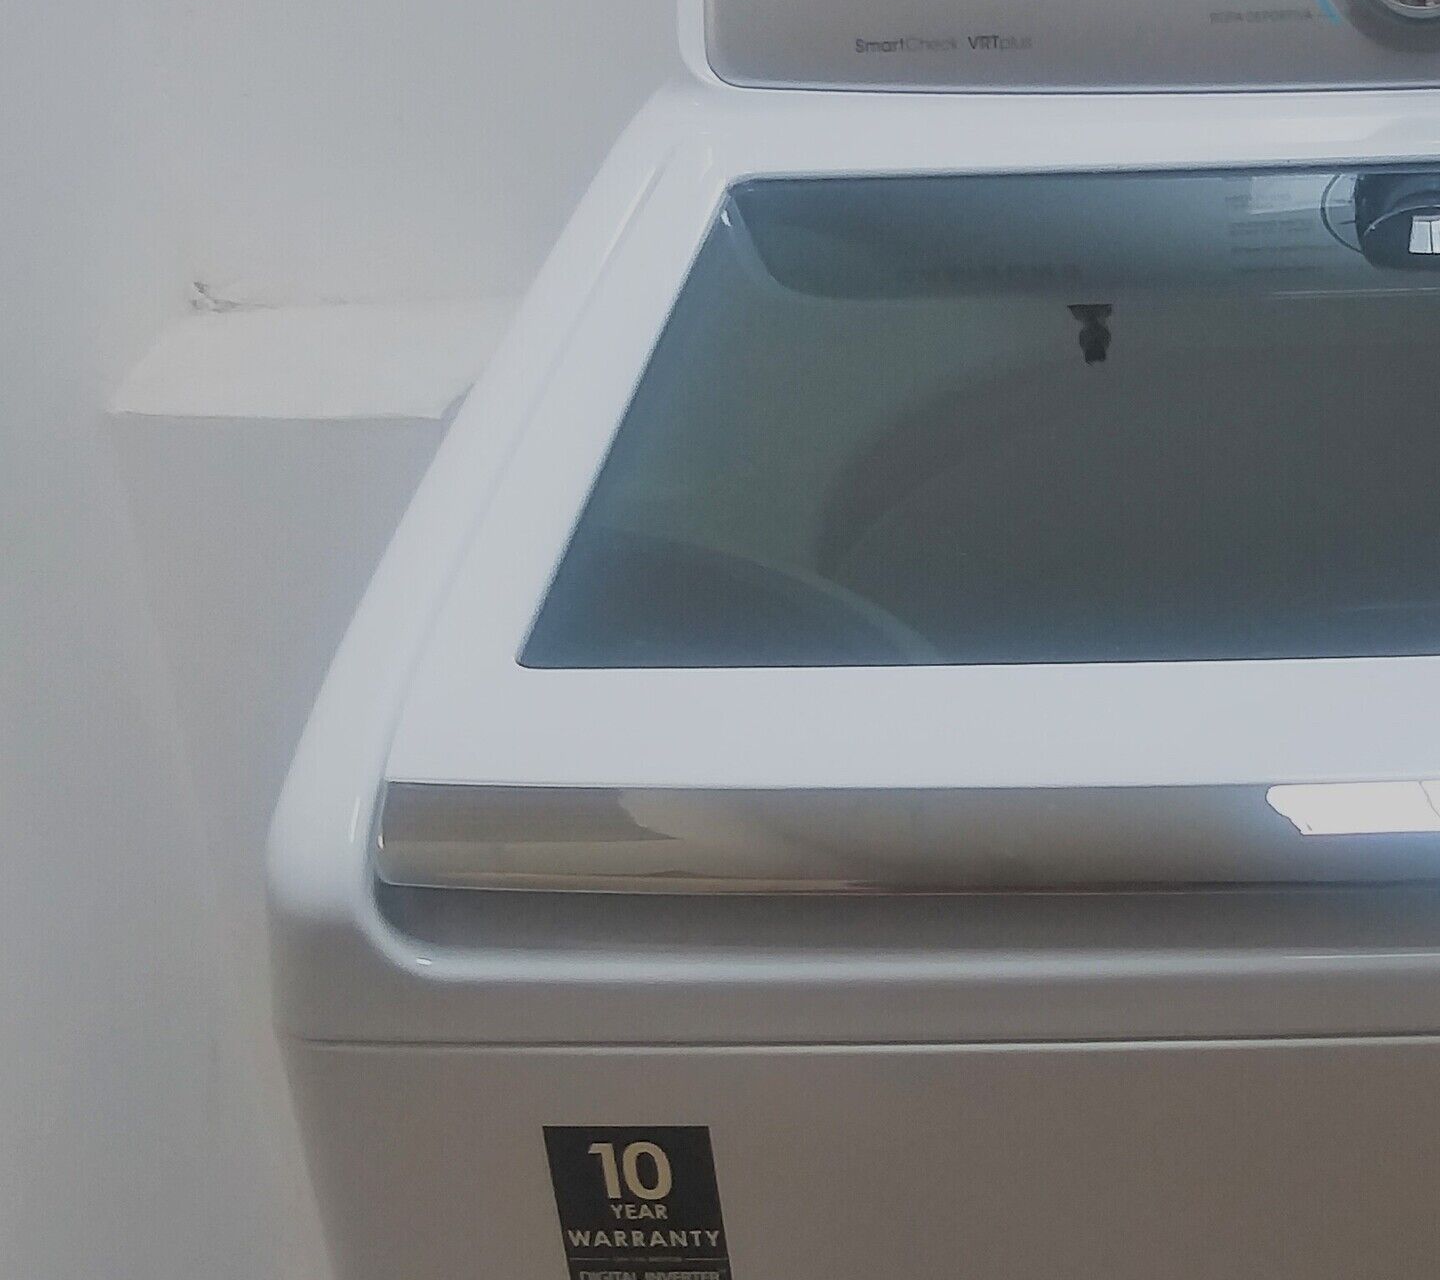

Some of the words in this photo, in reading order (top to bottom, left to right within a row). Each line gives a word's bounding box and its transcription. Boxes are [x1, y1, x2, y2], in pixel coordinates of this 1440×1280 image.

[588, 1141, 673, 1200] 10
[611, 1204, 668, 1220] YEAR
[568, 1230, 721, 1248] WARRANTY
